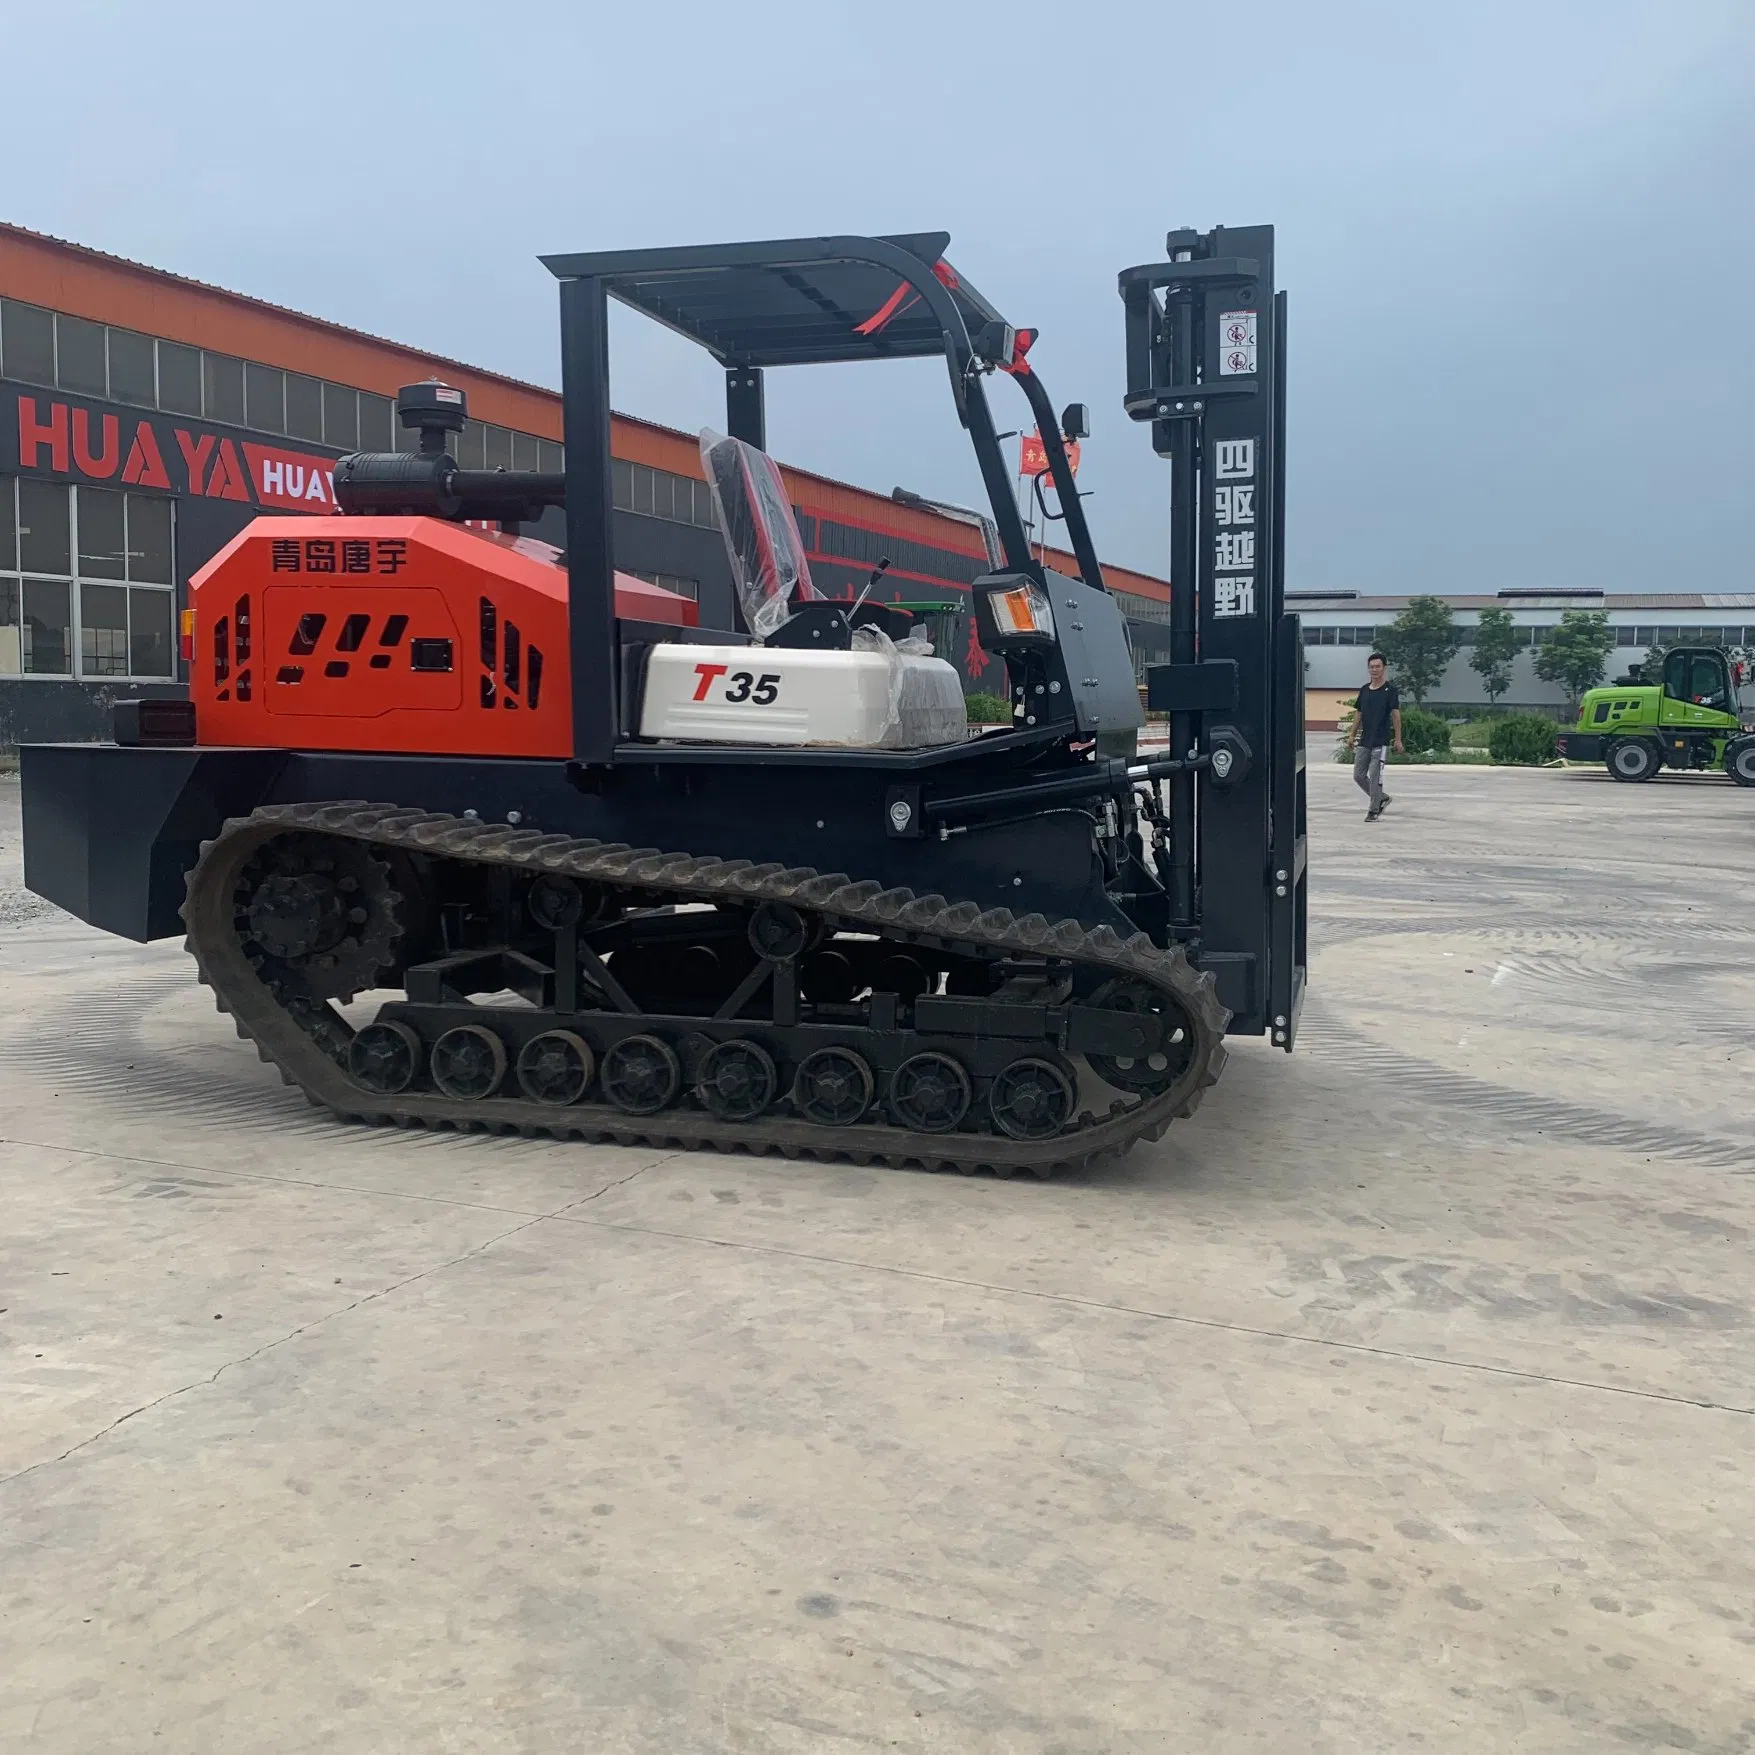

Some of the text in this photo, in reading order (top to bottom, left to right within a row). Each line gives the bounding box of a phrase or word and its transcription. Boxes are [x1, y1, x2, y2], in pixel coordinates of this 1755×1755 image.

[1214, 439, 1255, 617] 四驱越野
[272, 539, 407, 574] 青岛唐宇
[692, 663, 781, 706] T35
